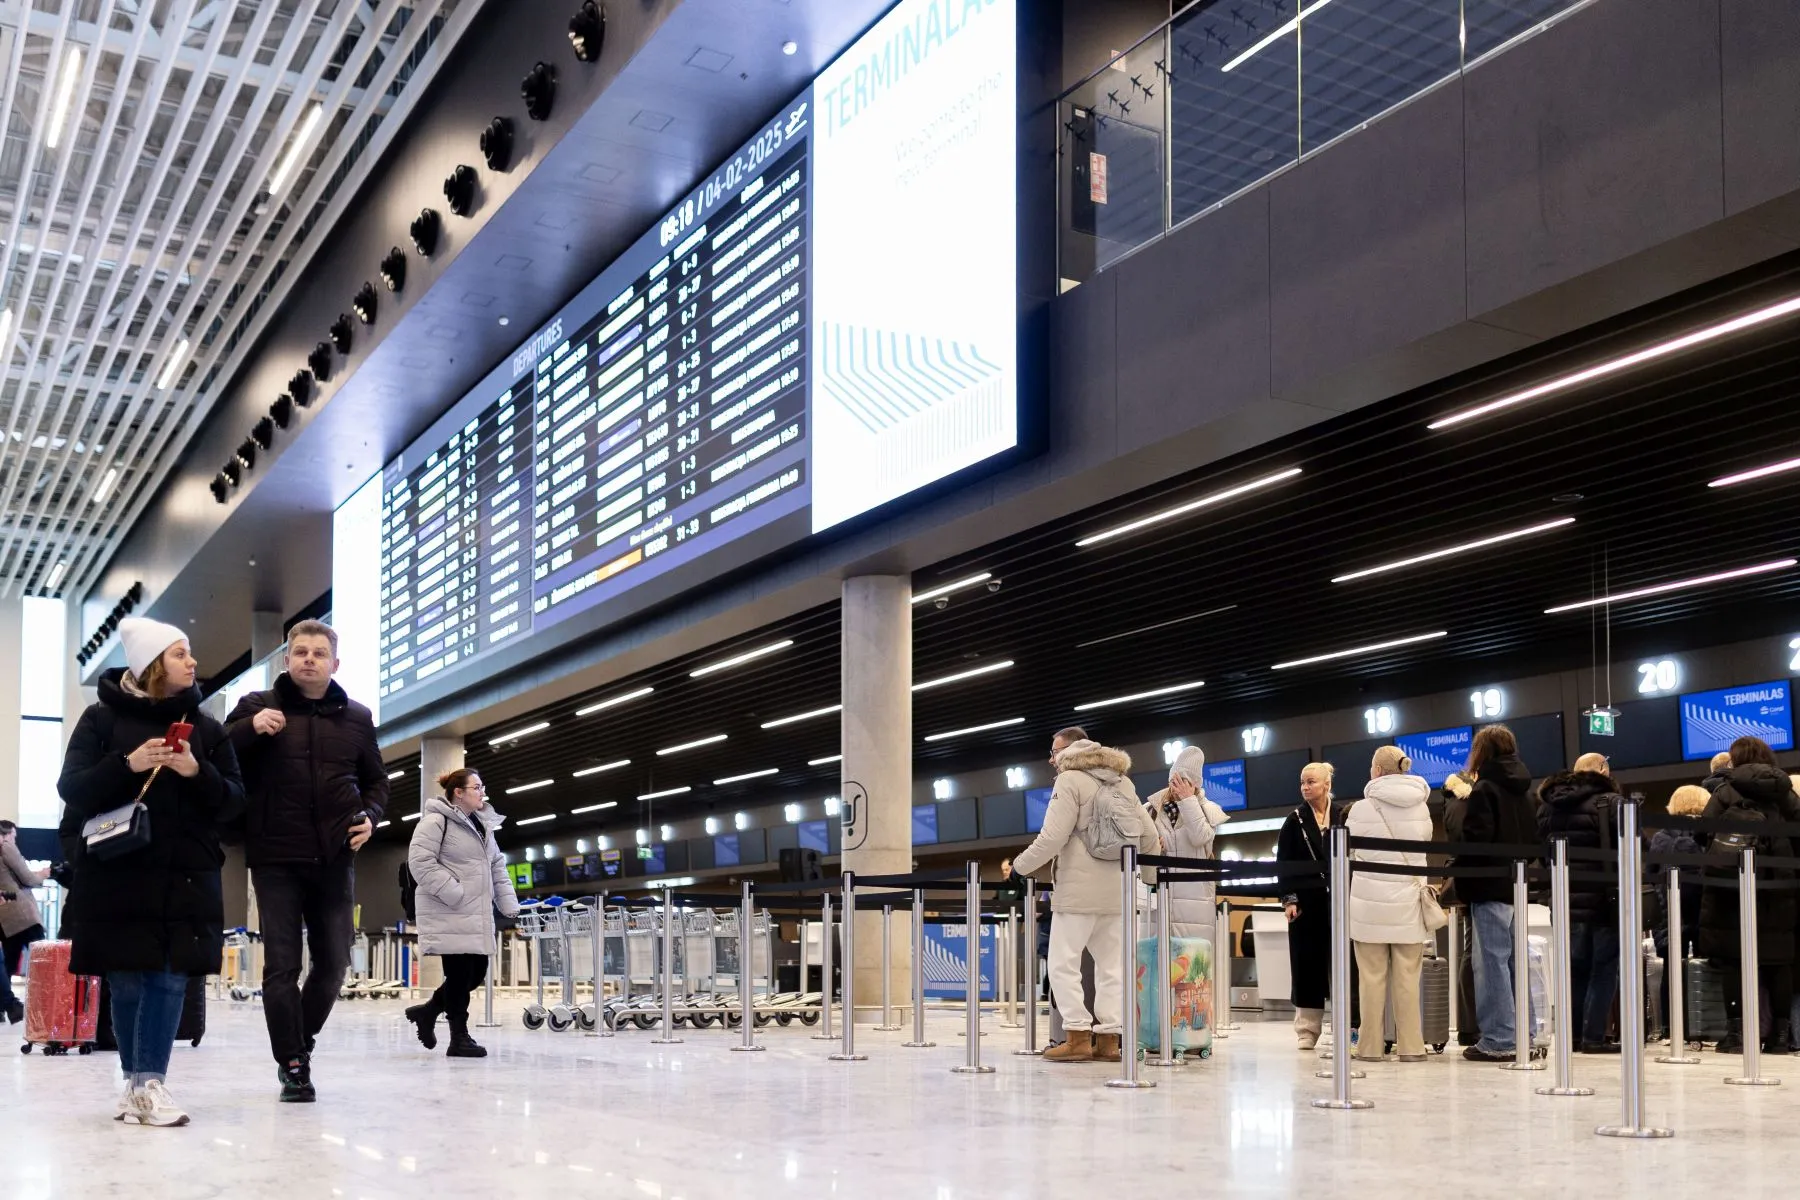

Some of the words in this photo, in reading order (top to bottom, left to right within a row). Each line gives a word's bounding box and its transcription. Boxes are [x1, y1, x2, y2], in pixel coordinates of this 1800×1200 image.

[705, 120, 783, 209] 04-02-2025
[512, 317, 564, 379] DEPARTURES
[1637, 660, 1678, 694] 20
[1470, 688, 1502, 718] 19
[1723, 687, 1785, 707] TERMINALAS
[1363, 706, 1393, 734] 18
[1241, 726, 1265, 753] 17
[1425, 731, 1469, 748] TERMINALAS
[1209, 764, 1242, 777] TERMINALAS
